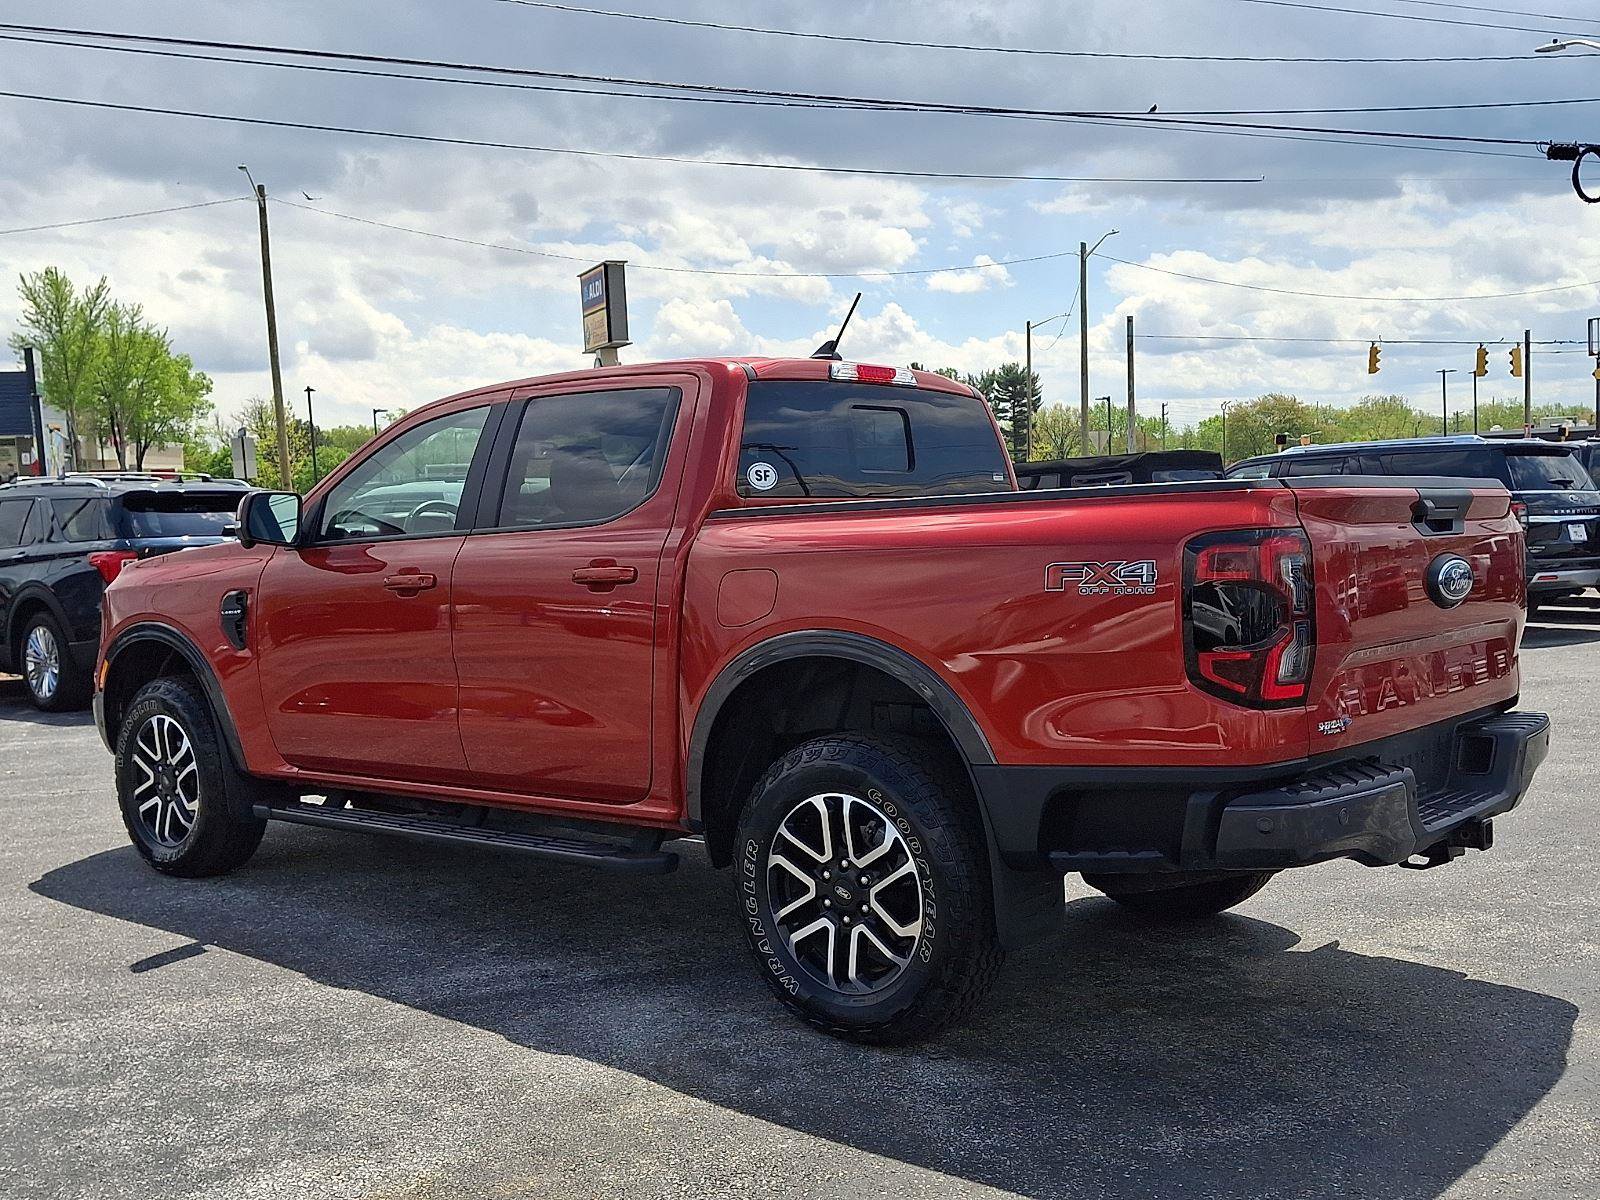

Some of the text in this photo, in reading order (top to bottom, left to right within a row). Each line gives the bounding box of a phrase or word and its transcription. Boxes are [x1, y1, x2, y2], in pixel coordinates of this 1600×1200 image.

[589, 279, 602, 298] ALDI
[755, 469, 770, 481] SF
[1045, 560, 1157, 591] FX4
[1450, 568, 1471, 590] Ford
[1079, 586, 1156, 595] OFF ROAD
[1337, 648, 1512, 716] RANGER
[867, 788, 936, 963] GOODYEAR
[744, 839, 800, 995] WRANGLER
